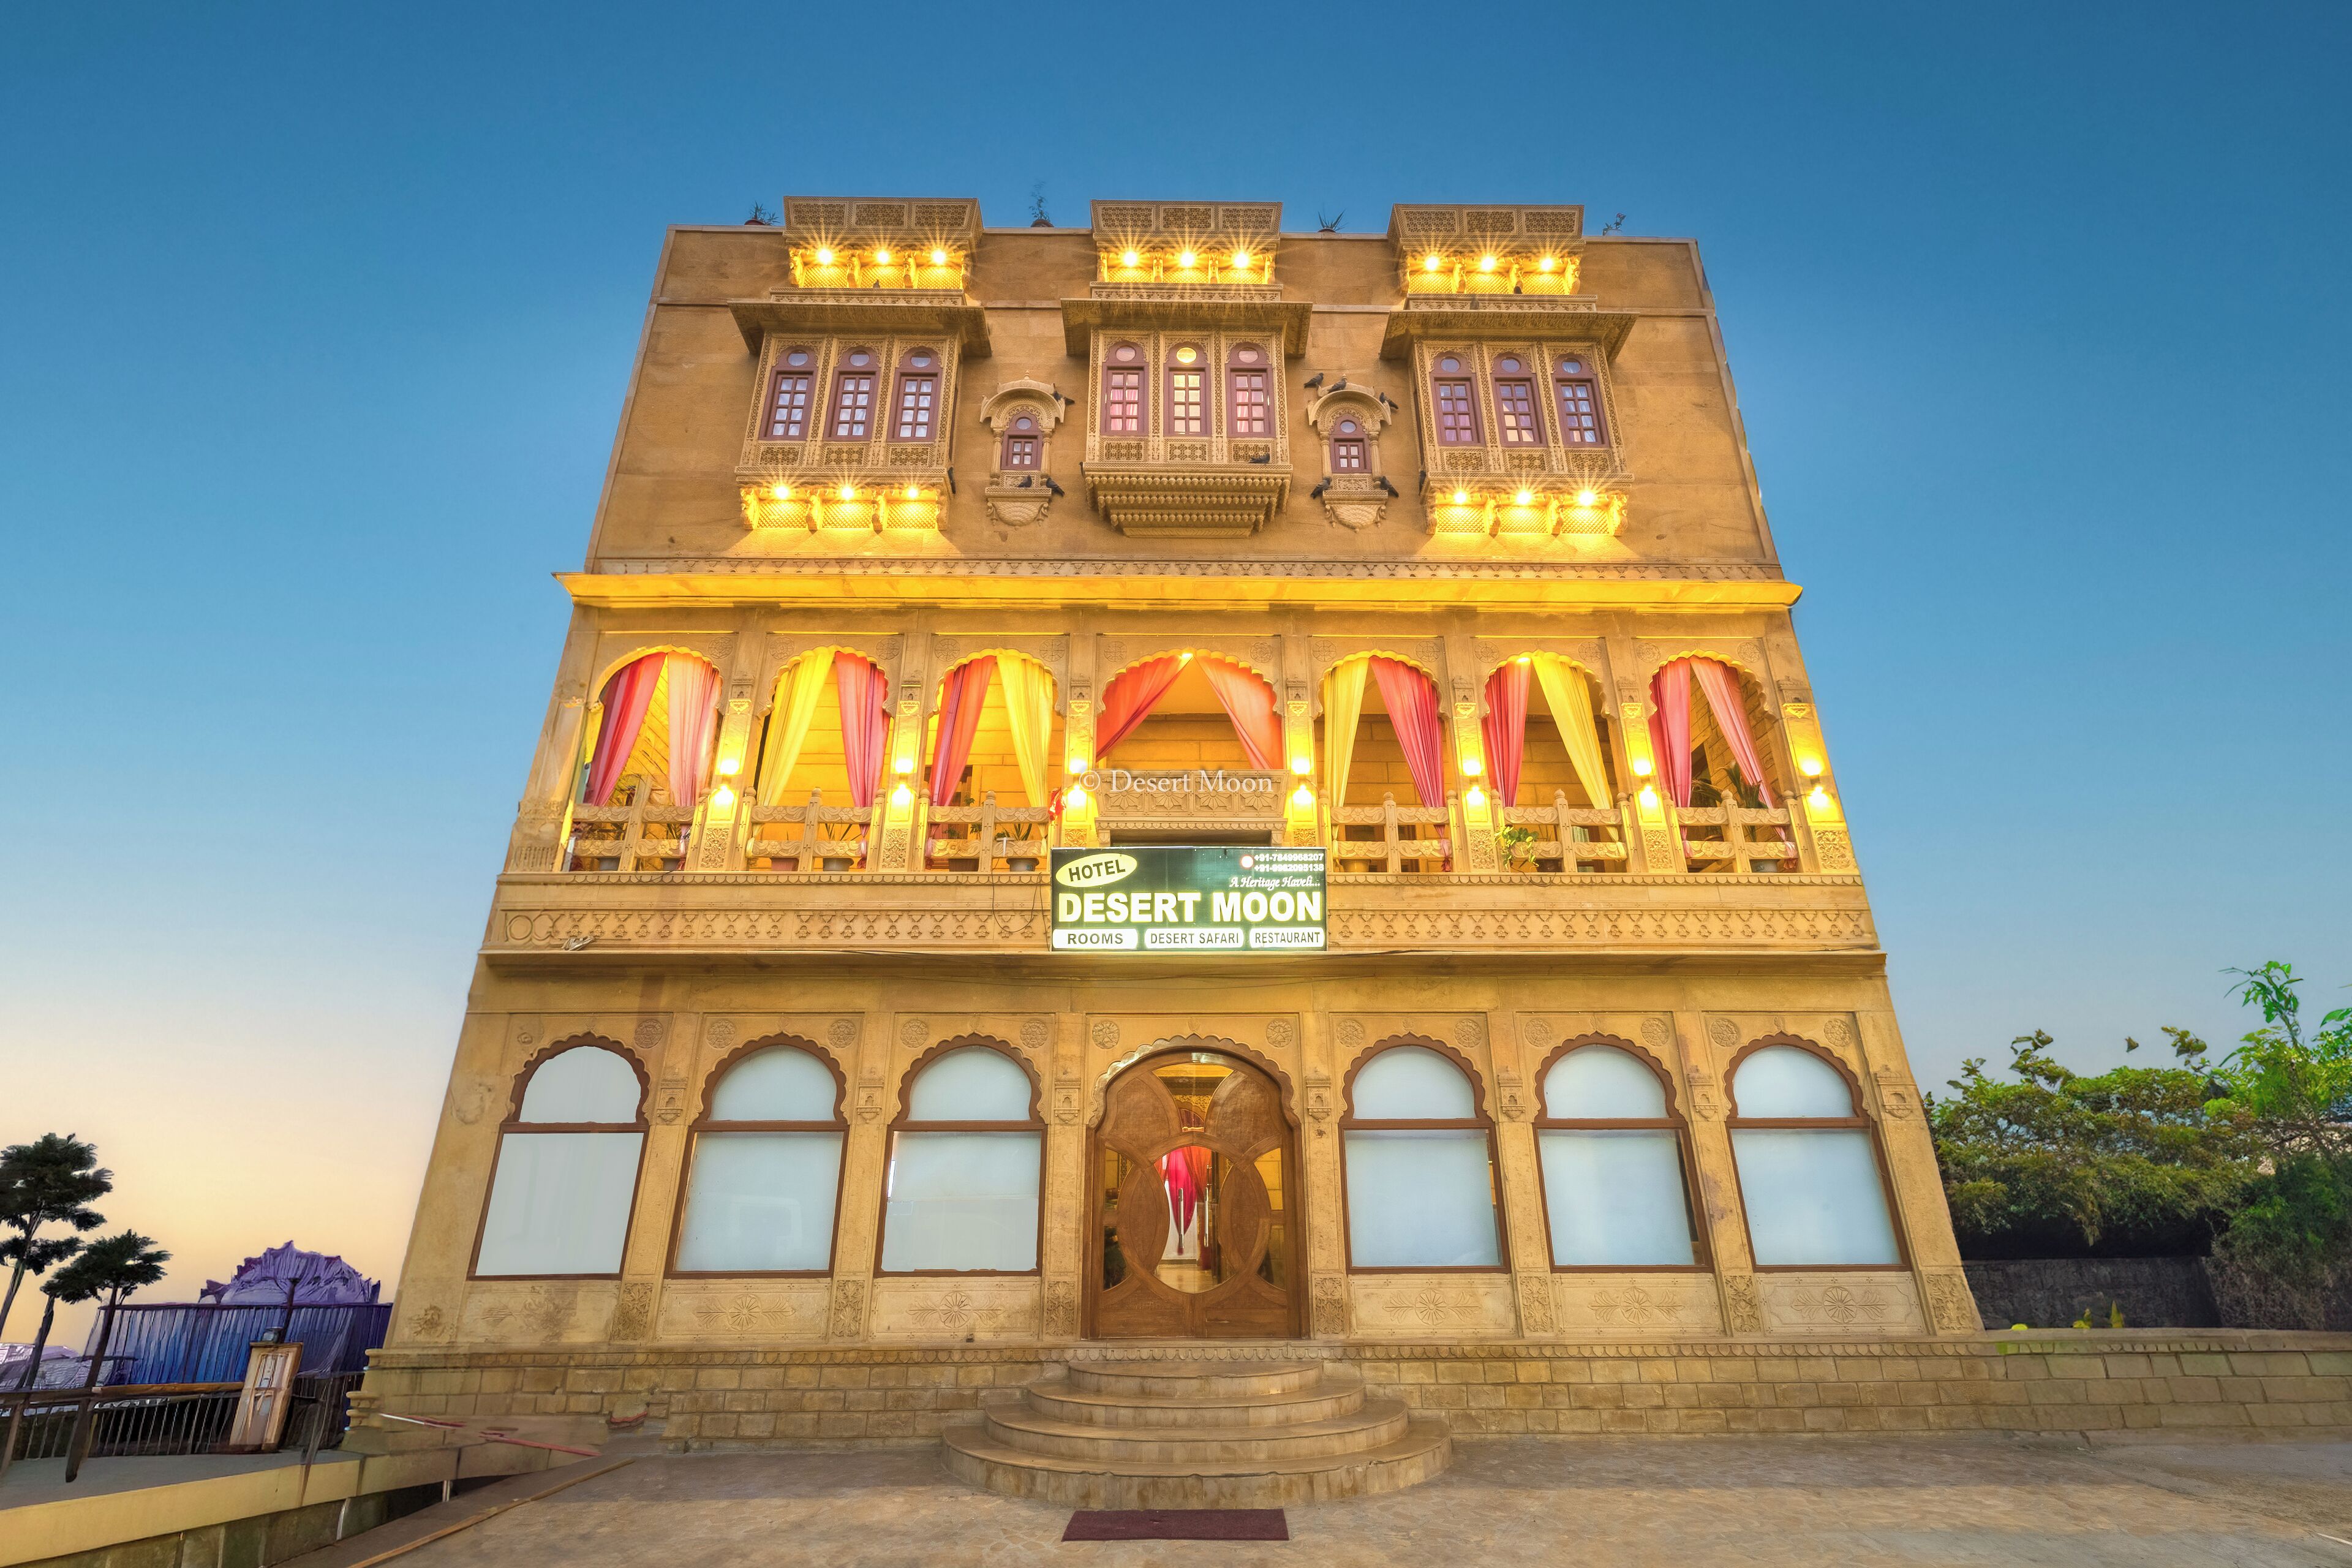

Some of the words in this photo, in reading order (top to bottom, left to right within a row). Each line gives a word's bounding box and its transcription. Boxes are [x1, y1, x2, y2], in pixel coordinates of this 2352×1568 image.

[1068, 859, 1126, 882] HOTEL
[1229, 876, 1240, 888] A
[1240, 876, 1280, 891] Heritage
[1058, 892, 1201, 922] DESERT
[1213, 892, 1321, 921] MOON
[1067, 933, 1123, 944] ROOMS
[1150, 933, 1194, 944] DESERT
[1199, 932, 1239, 943] SAFARI
[1254, 932, 1320, 944] RESTAURANT
